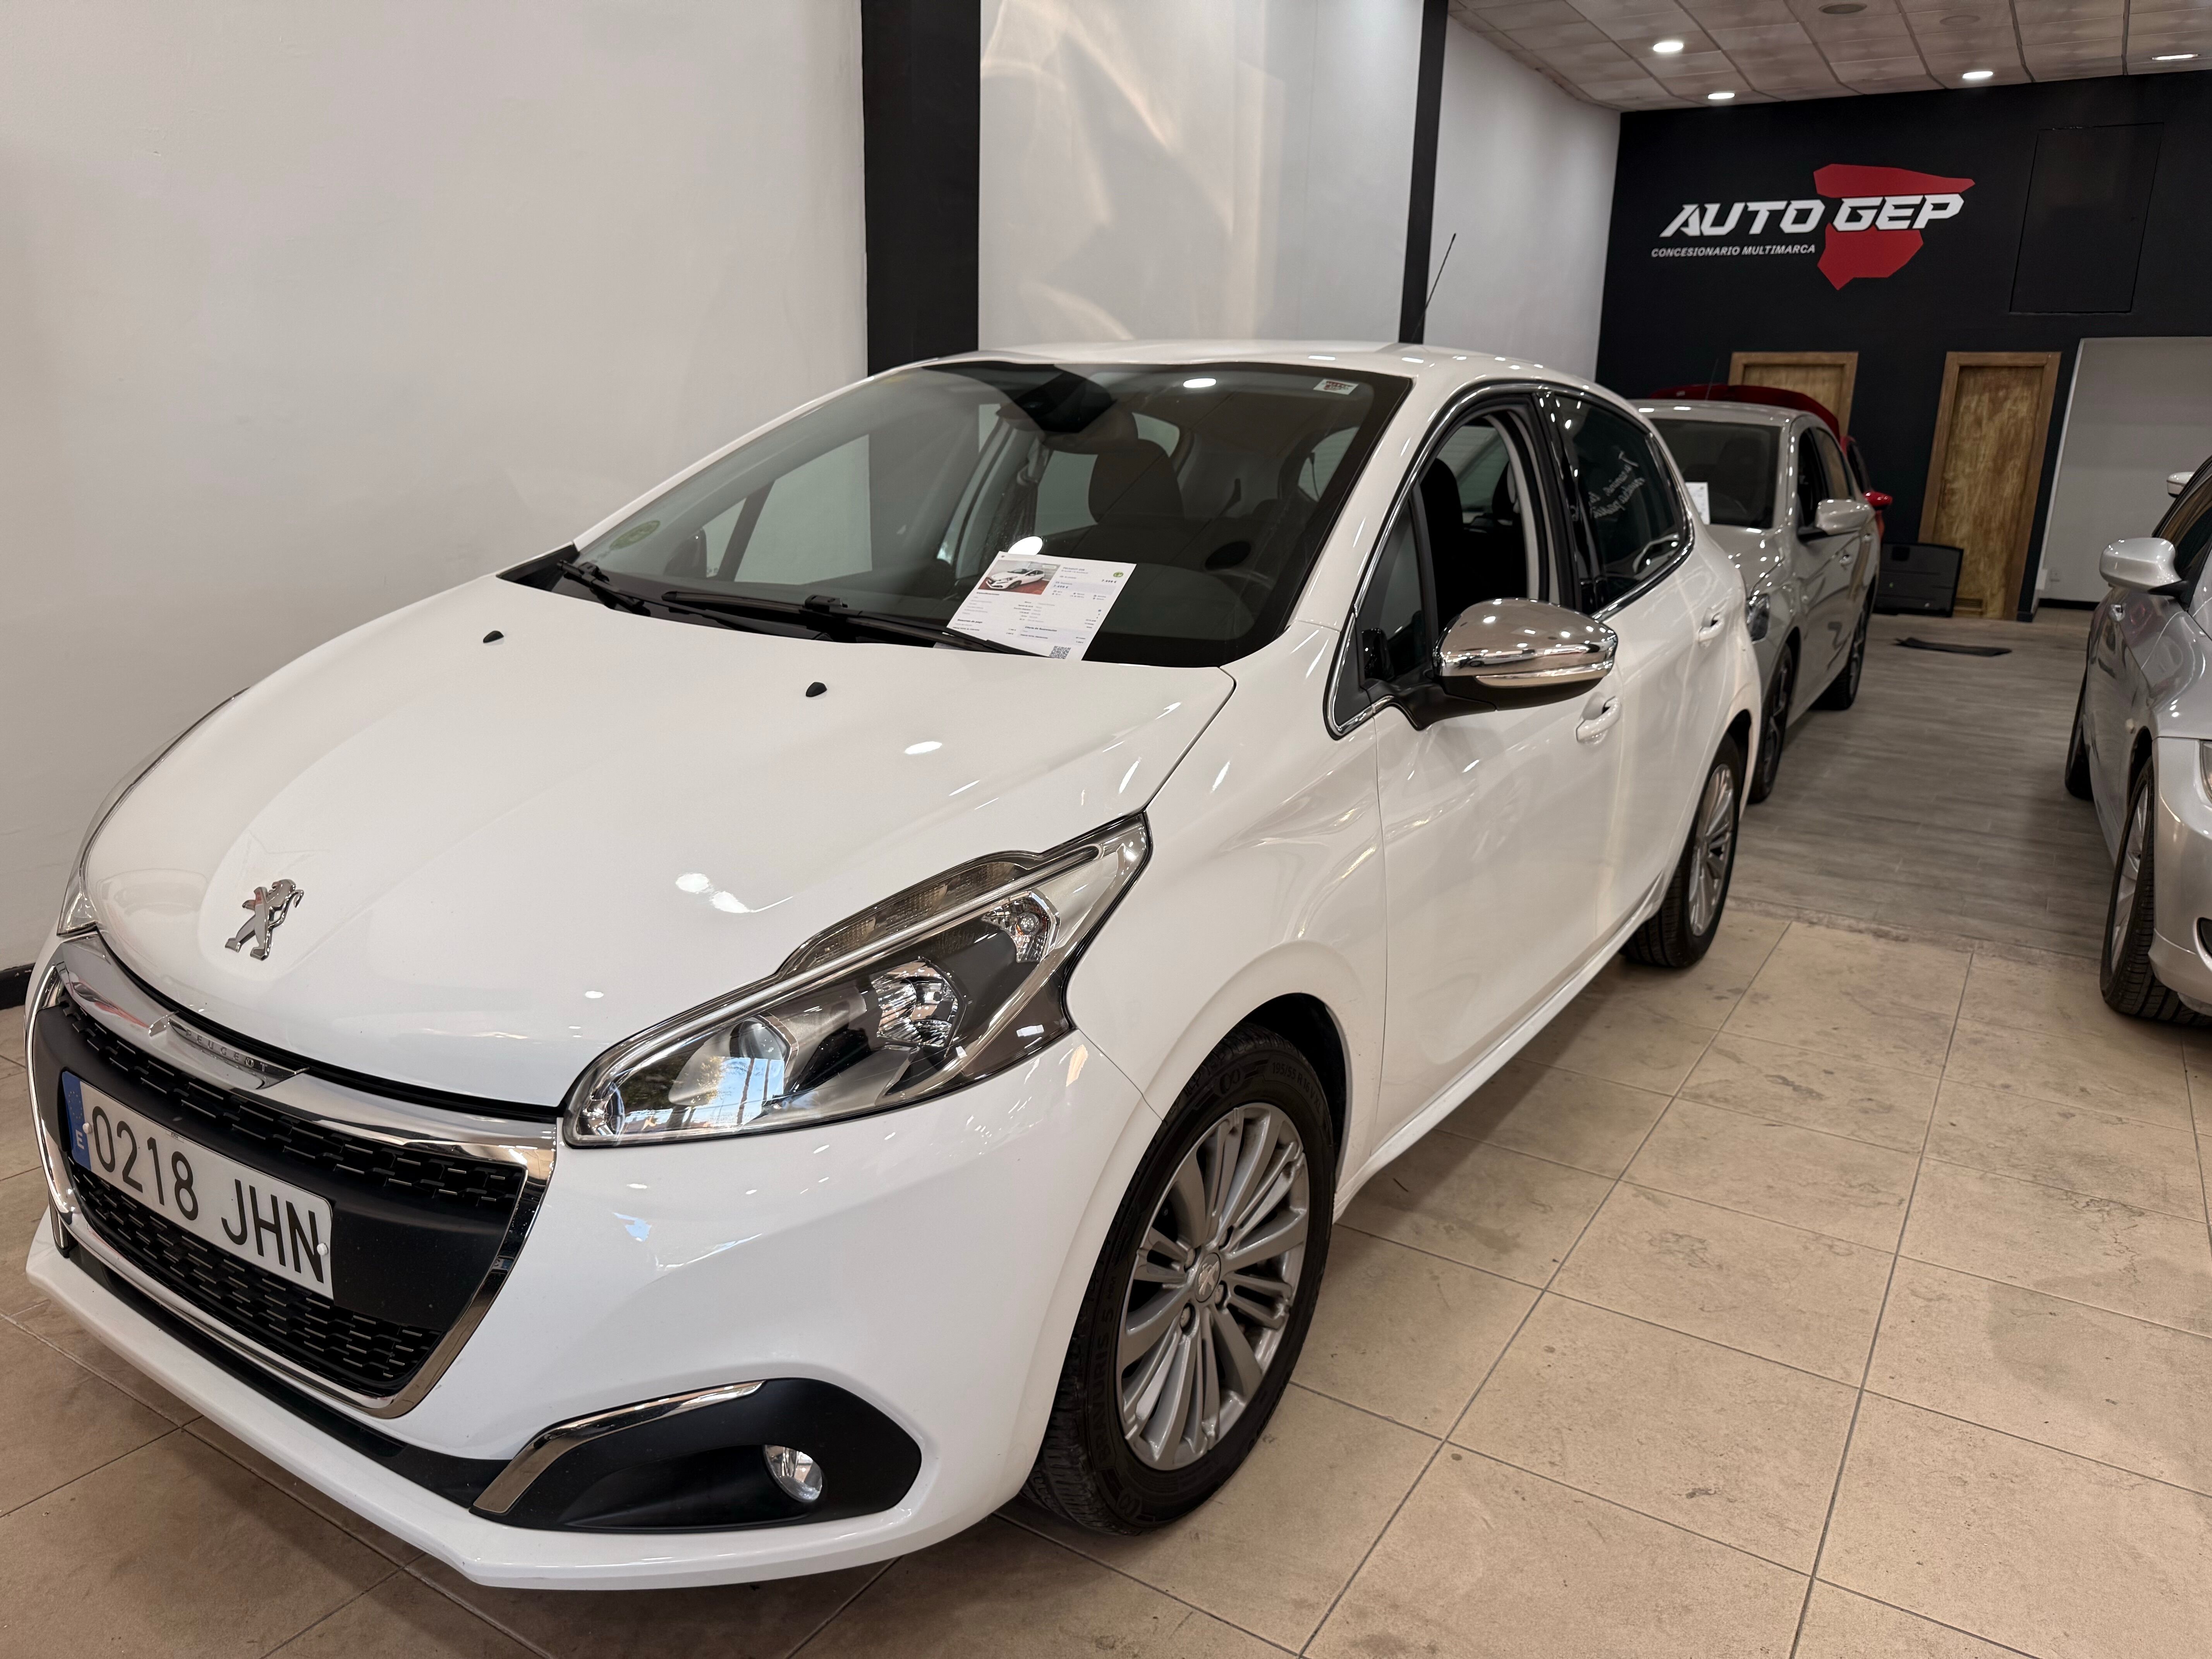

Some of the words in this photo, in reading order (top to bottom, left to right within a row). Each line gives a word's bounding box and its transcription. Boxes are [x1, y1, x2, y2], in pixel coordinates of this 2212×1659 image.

[1659, 199, 1825, 237] AUTO
[1832, 194, 1965, 232] GEP
[1651, 246, 1741, 258] CONCESIONARIO
[1741, 244, 1815, 255] MULTIMARCA
[185, 1029, 268, 1072] PEUGEOT
[1273, 1061, 1297, 1080] 195/55
[75, 1128, 84, 1149] E
[92, 1106, 199, 1221] 0218
[221, 1179, 324, 1283] JHN
